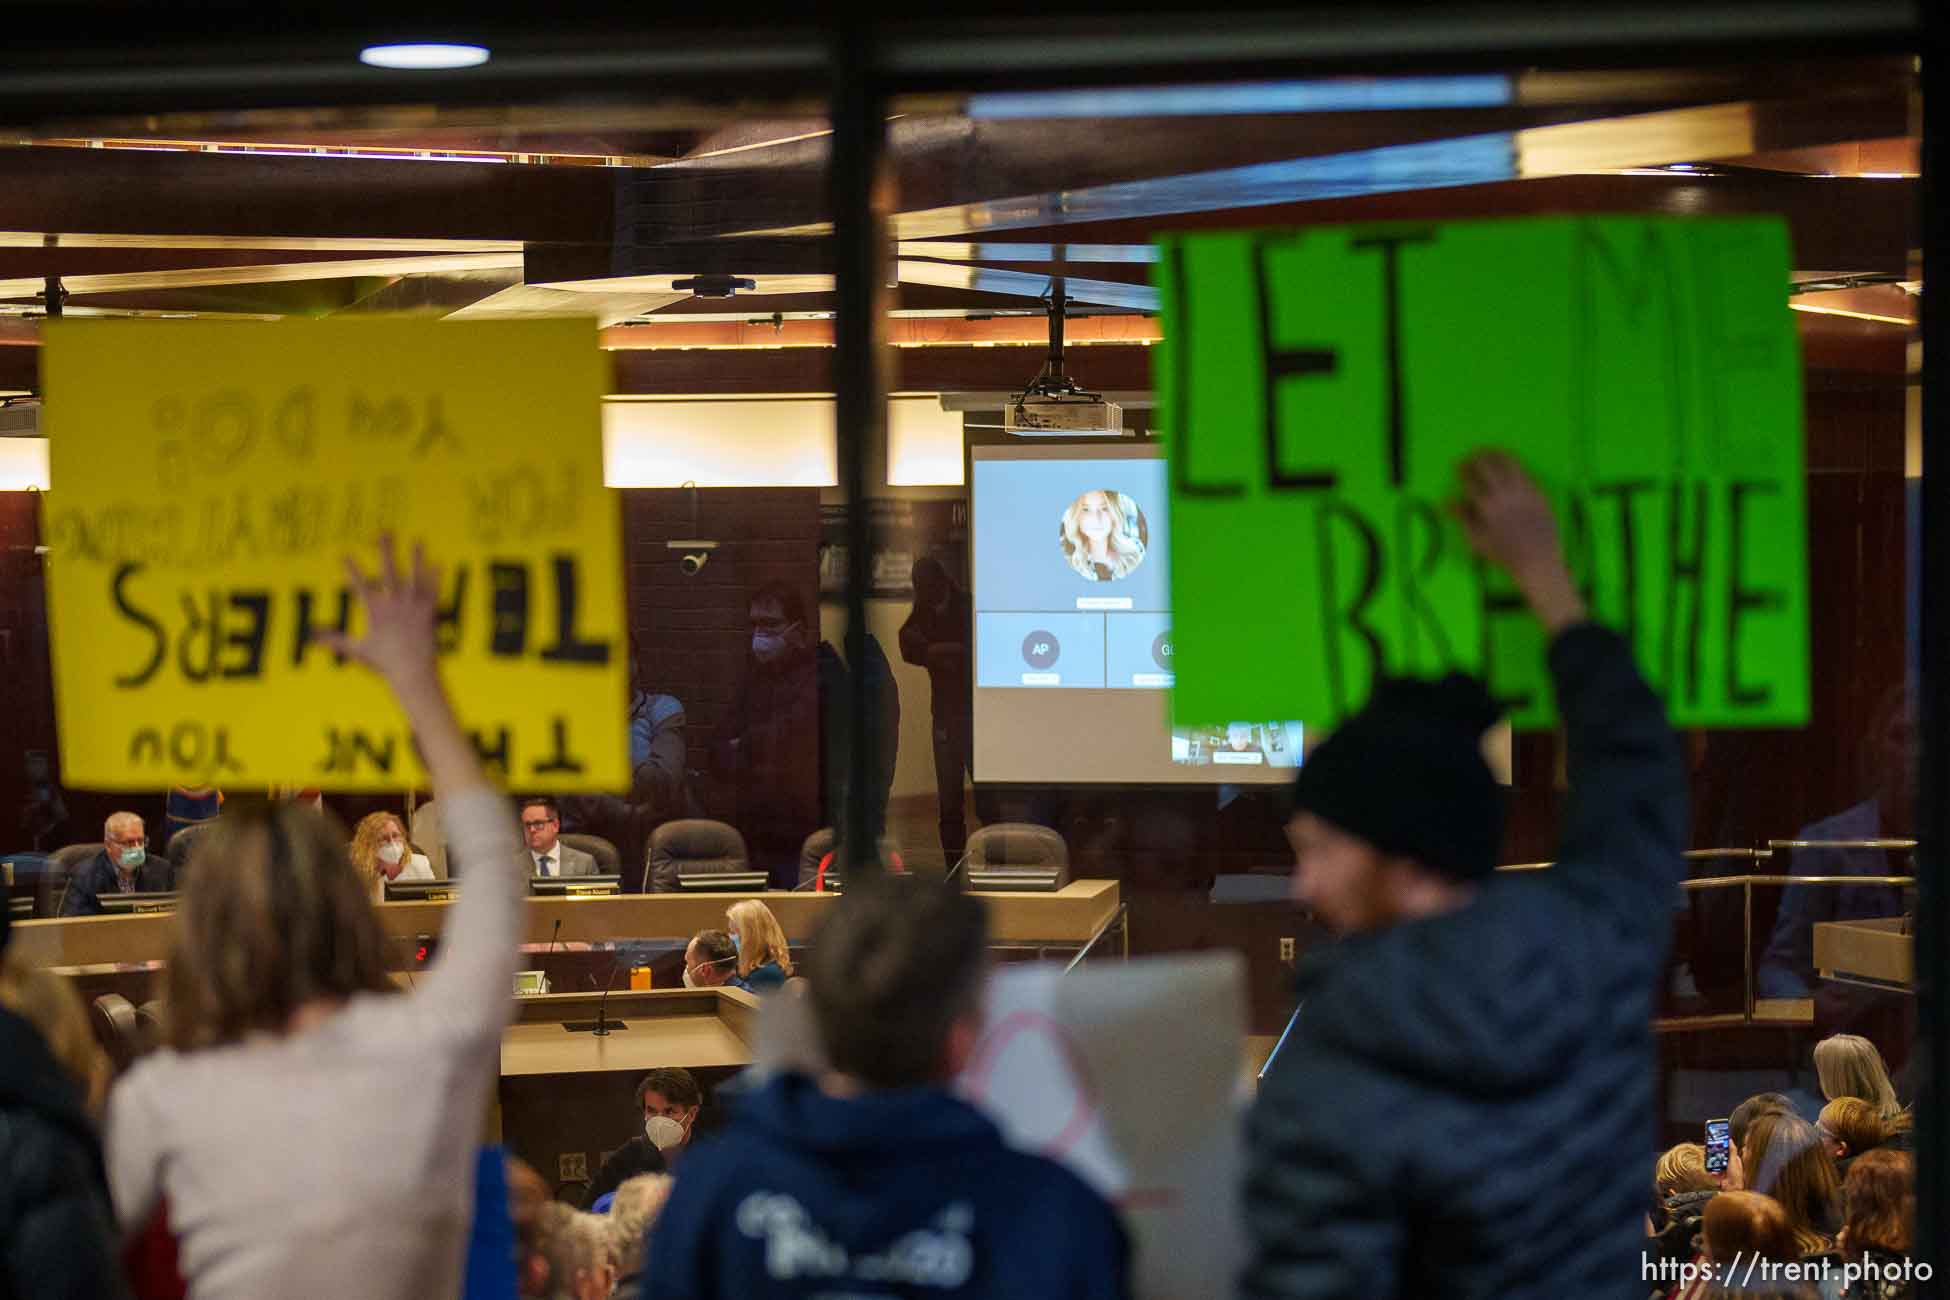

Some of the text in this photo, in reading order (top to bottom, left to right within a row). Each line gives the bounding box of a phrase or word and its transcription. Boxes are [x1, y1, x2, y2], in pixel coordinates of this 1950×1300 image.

[1169, 225, 1438, 497] LET
[1031, 642, 1049, 656] AP
[128, 719, 243, 776] YOU
